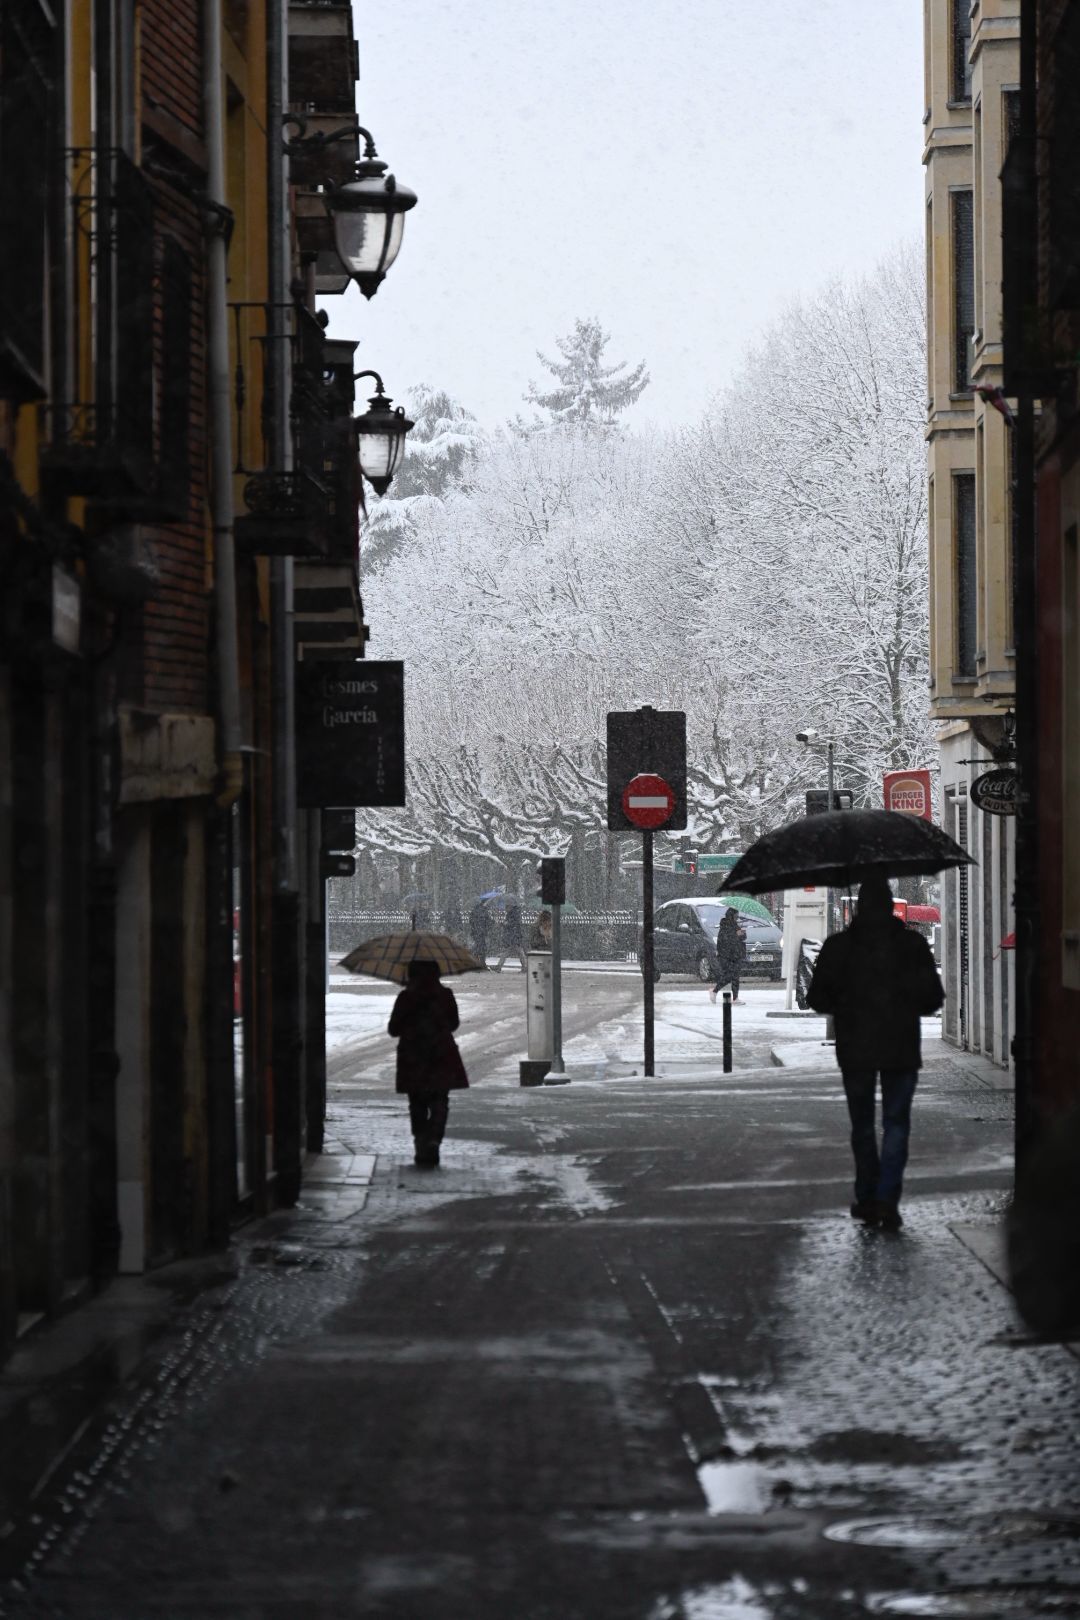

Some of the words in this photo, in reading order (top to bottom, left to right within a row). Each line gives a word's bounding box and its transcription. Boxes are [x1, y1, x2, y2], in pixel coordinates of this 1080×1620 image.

[322, 704, 379, 728] García
[891, 791, 924, 800] BURGER
[891, 798, 924, 810] KING
